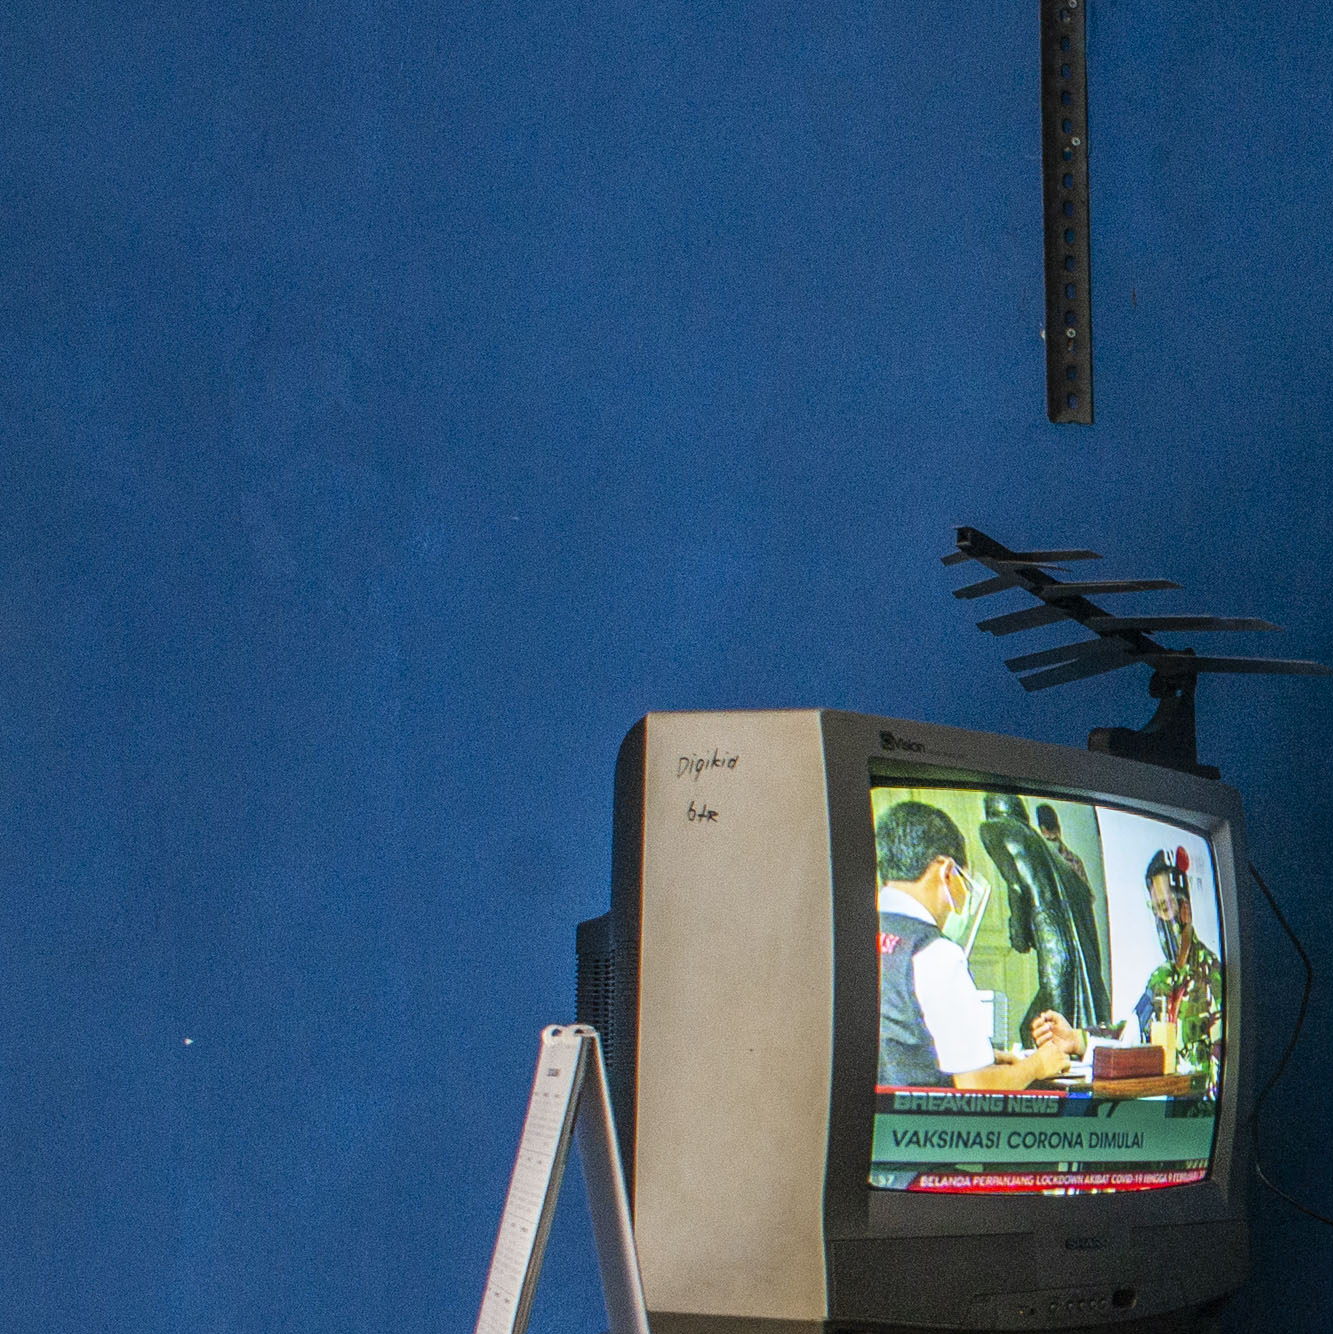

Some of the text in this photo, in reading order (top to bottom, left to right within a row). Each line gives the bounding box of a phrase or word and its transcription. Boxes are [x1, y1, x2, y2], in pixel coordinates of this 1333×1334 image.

[893, 1092, 1060, 1115] BREAKING NEWS
[892, 1130, 1145, 1149] VAKSINASI CORONA DIMULAI
[920, 1174, 971, 1188] BELANDA
[973, 1175, 1034, 1187] PERPANJANG
[1036, 1174, 1083, 1186] LOCKDOWN
